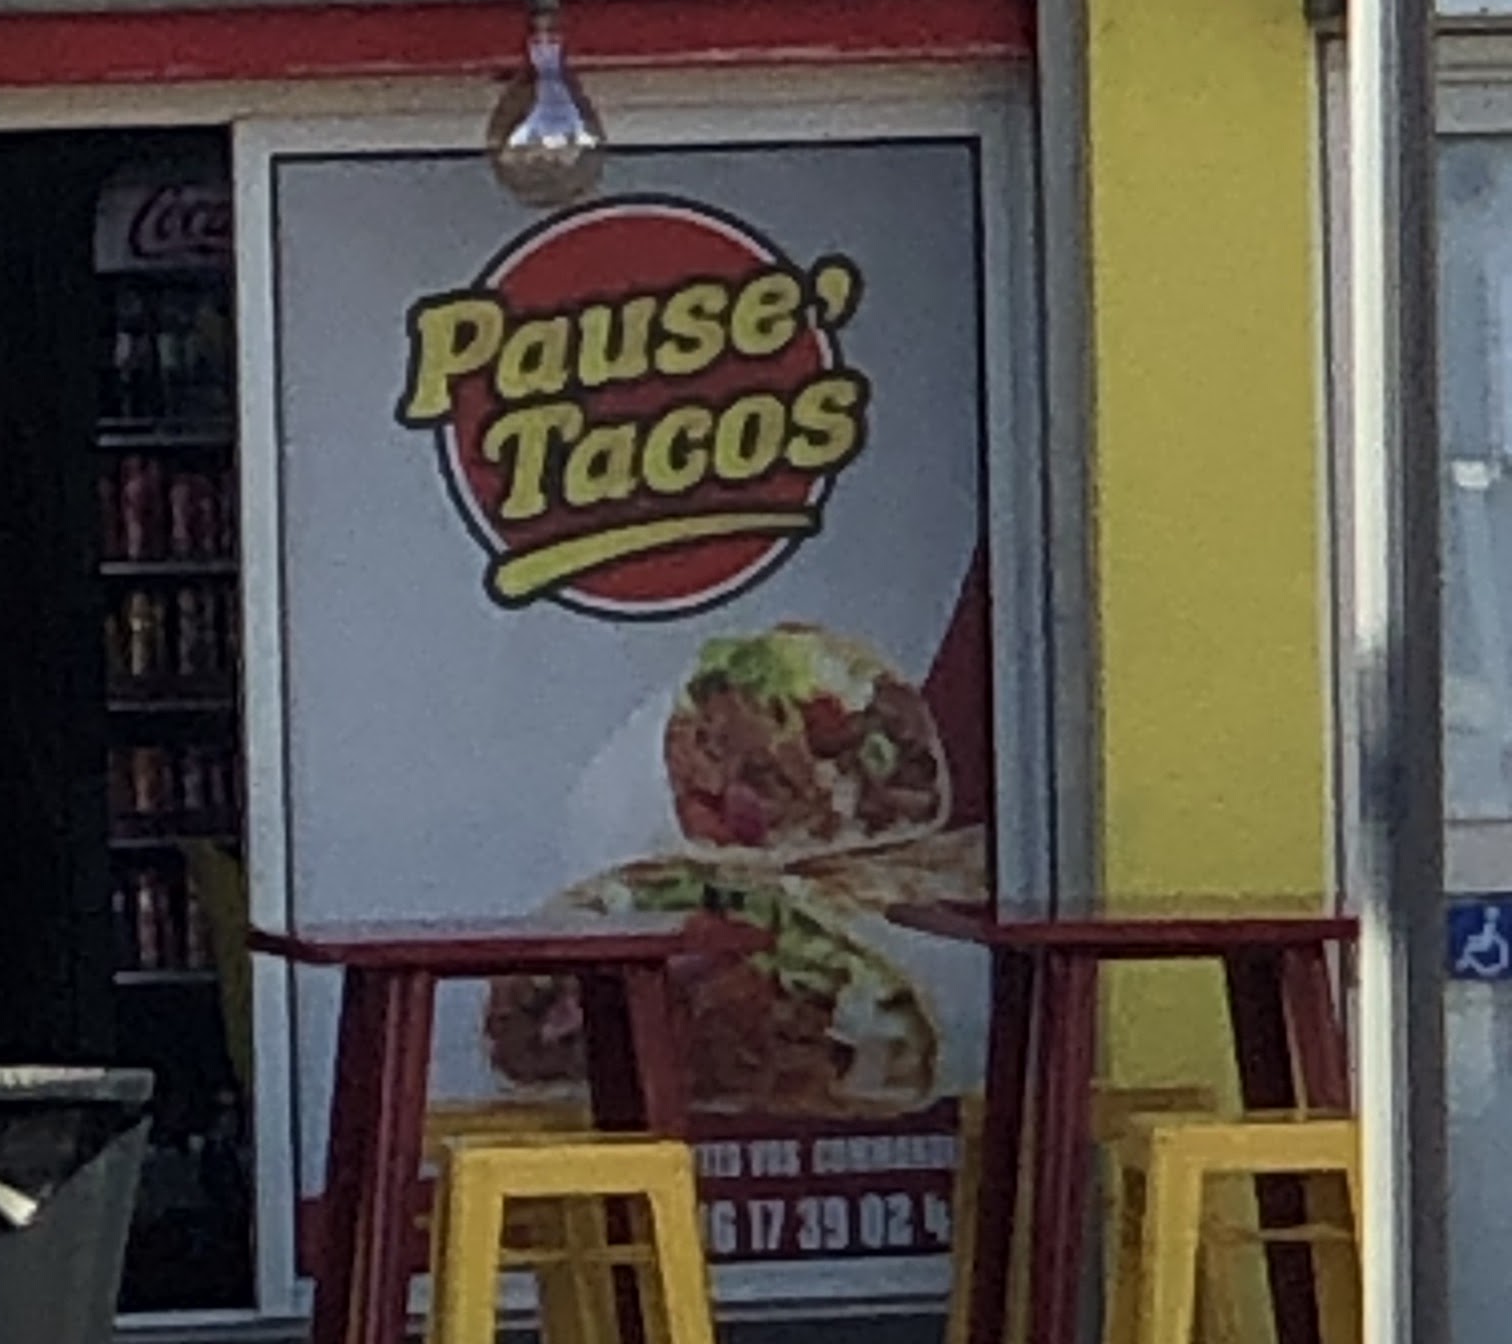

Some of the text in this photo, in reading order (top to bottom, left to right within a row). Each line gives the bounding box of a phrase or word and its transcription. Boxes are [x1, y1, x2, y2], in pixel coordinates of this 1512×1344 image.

[394, 252, 864, 429] Pause'
[479, 367, 872, 525] Tacos
[746, 1198, 786, 1251] 17
[859, 1191, 914, 1249] 02
